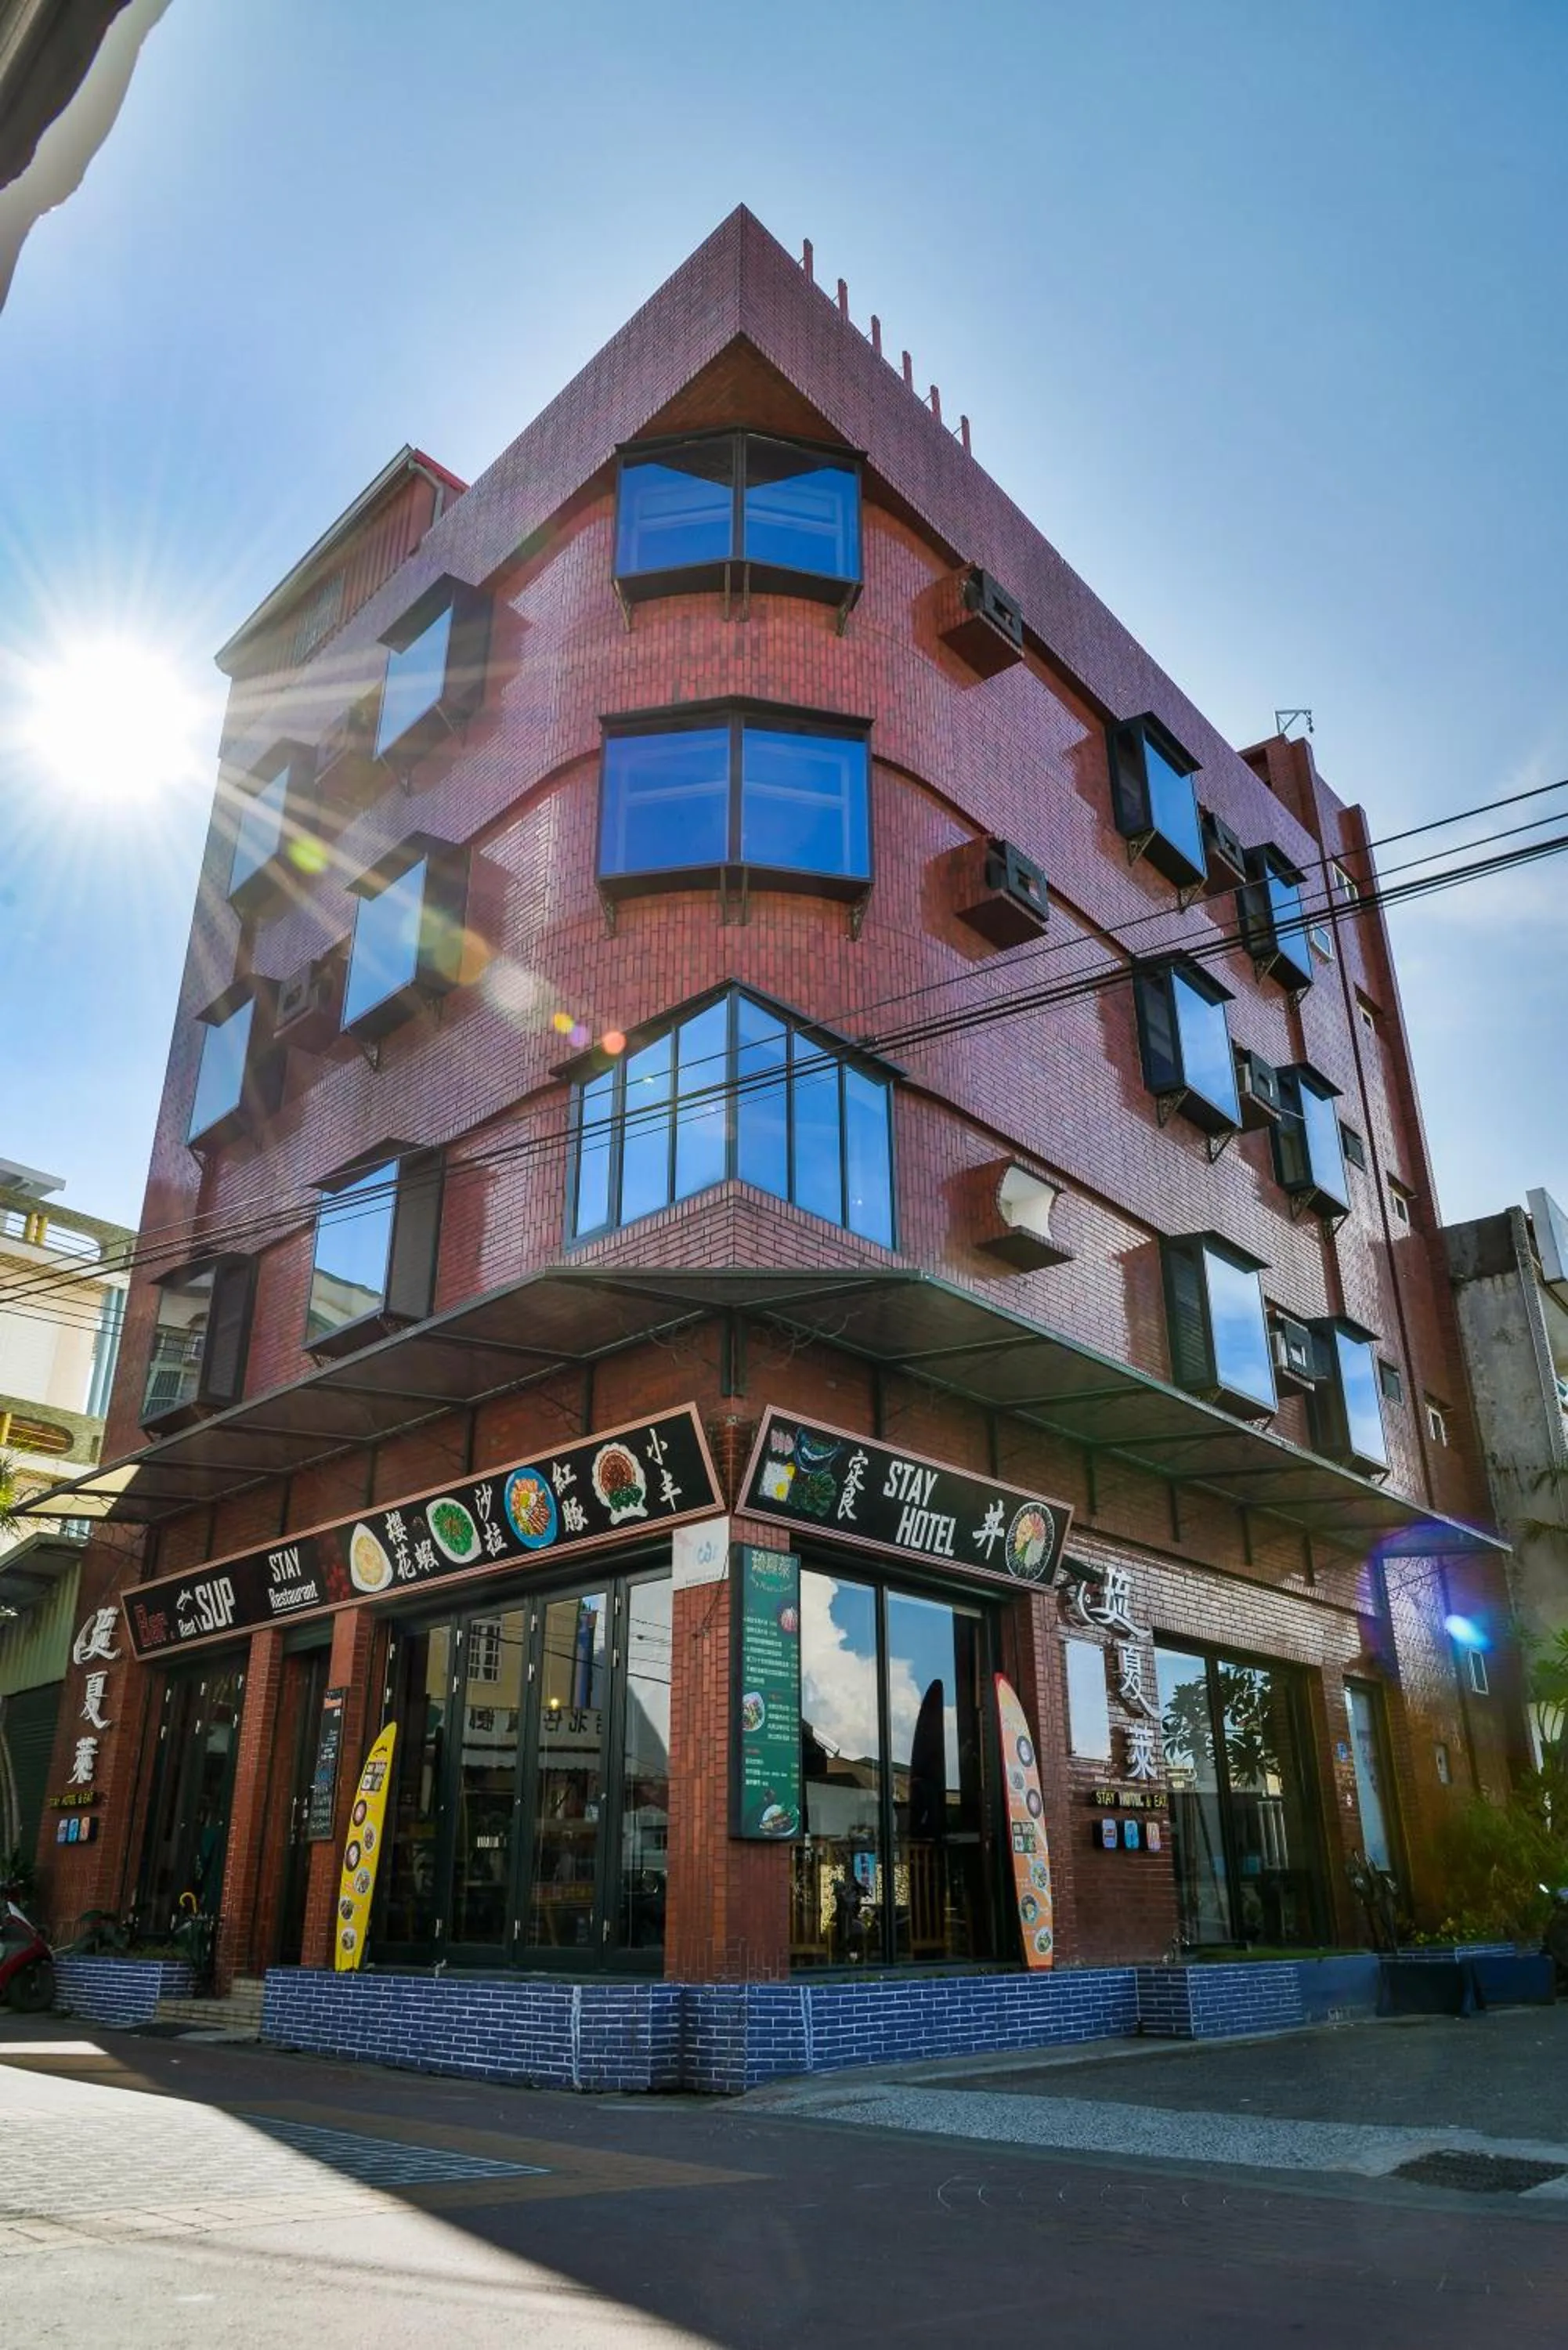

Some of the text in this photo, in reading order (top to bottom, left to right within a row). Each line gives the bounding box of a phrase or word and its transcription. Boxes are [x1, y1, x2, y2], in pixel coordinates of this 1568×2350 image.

[837, 1450, 868, 1520] 定食
[883, 1462, 938, 1507] STAY
[474, 1484, 508, 1557] 沙拉
[896, 1509, 957, 1556] HOTEL
[269, 1547, 301, 1583] STAY
[195, 1578, 236, 1631] SUP
[269, 1581, 319, 1608] Restaurant
[1096, 1791, 1115, 1806] STAY
